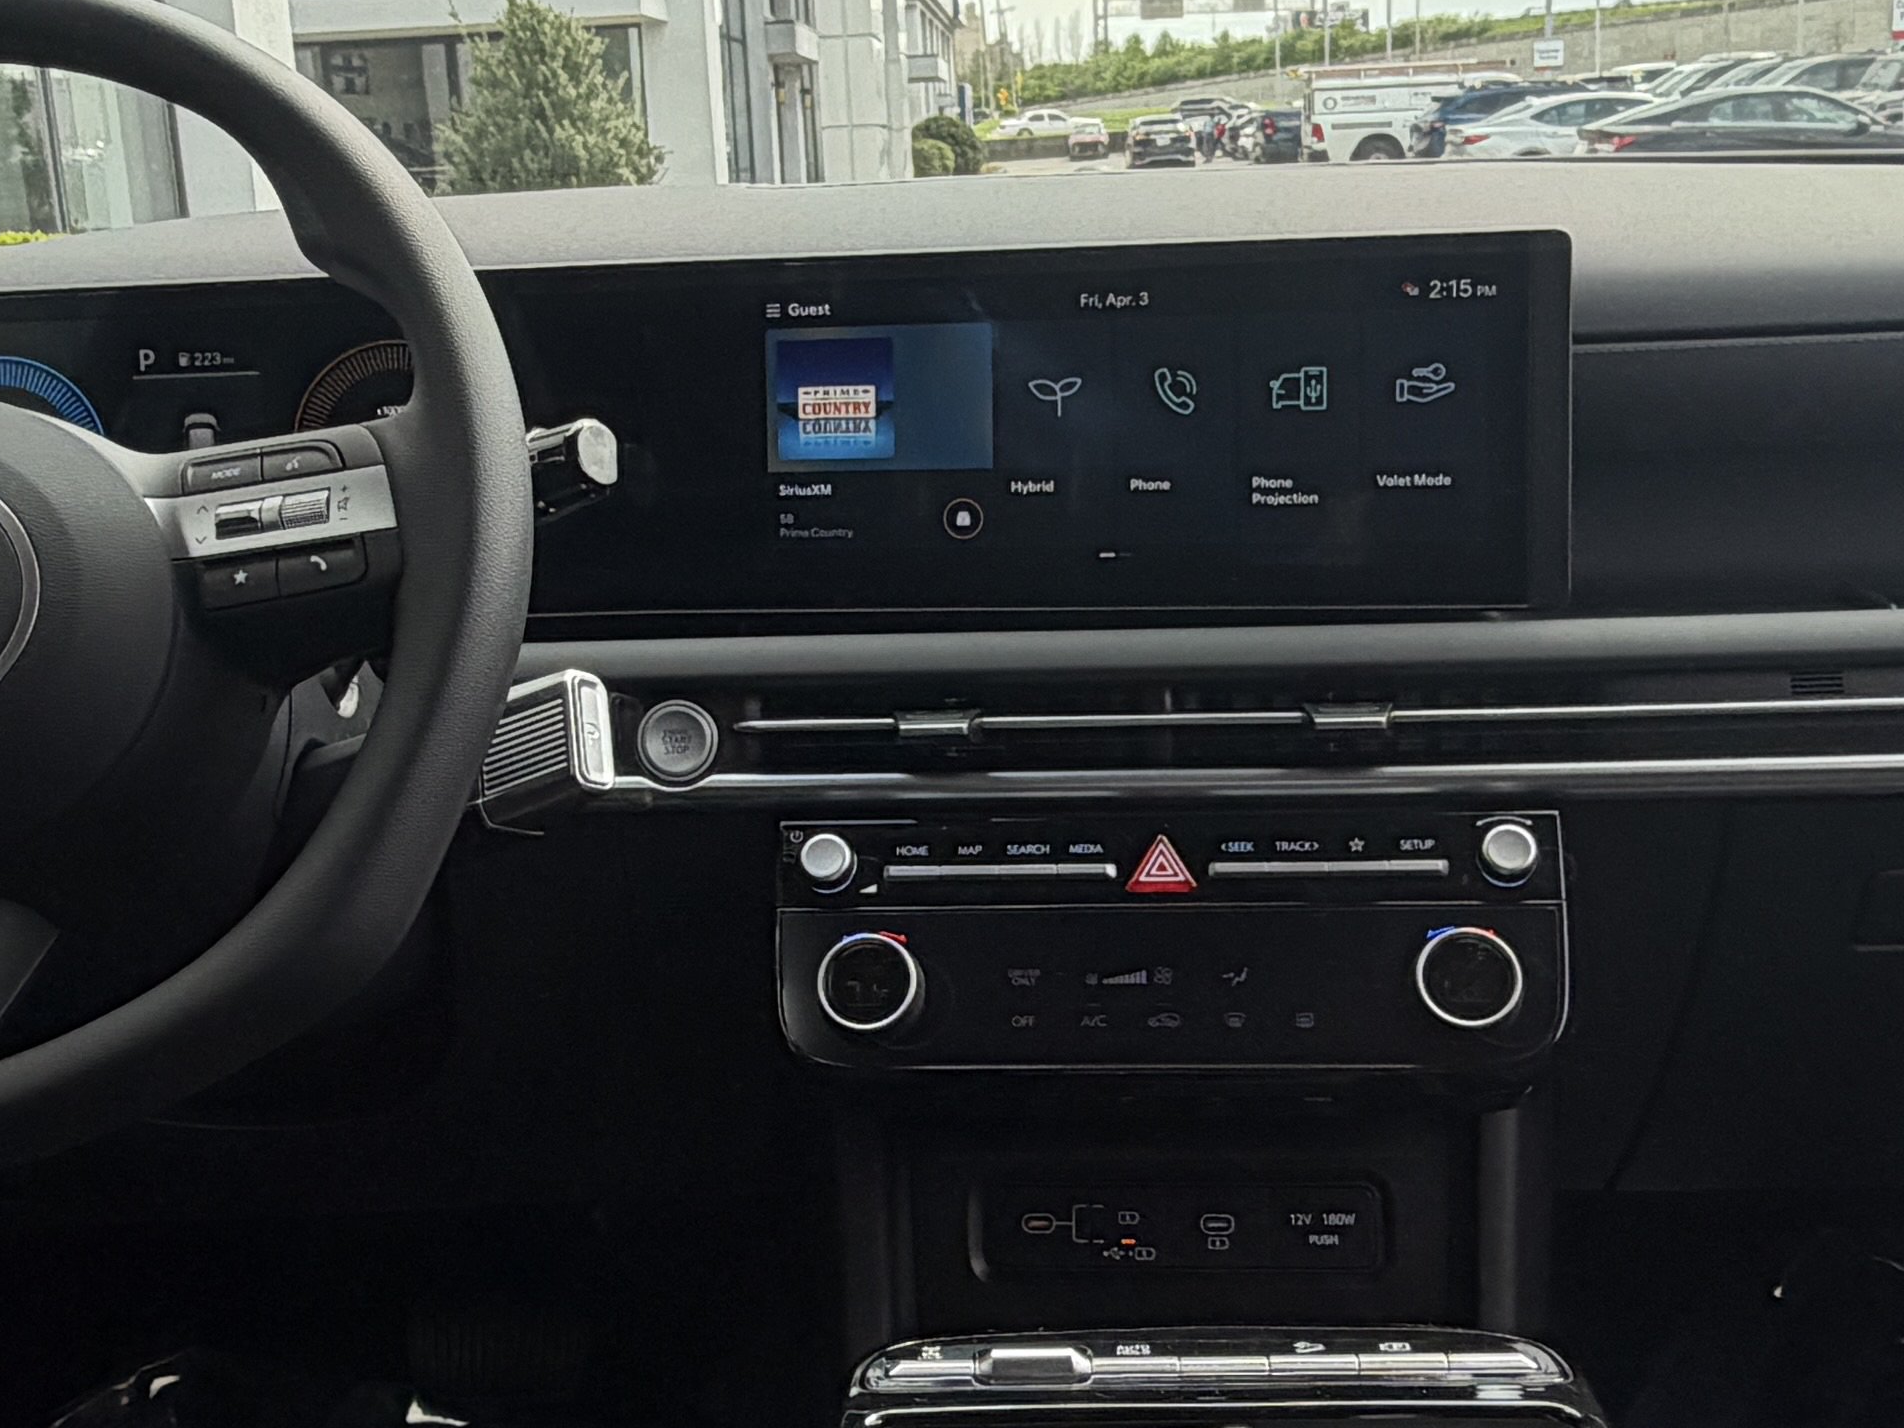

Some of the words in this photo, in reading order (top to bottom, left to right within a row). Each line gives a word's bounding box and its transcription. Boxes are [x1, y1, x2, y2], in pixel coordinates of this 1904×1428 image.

[1428, 279, 1473, 298] 2:15
[1476, 284, 1497, 297] PM
[1080, 293, 1103, 309] Fri,
[1105, 292, 1136, 308] Apr.
[1139, 291, 1150, 306] 3
[787, 303, 832, 317] Guest
[138, 348, 156, 372] P
[801, 401, 872, 416] COUNTRY
[1010, 479, 1055, 495] Hybrid
[1129, 478, 1172, 492] Phone
[1251, 475, 1294, 489] Phone
[1376, 474, 1412, 488] Valet
[1413, 472, 1453, 486] Mode
[778, 483, 833, 496] SiriusXM
[1251, 491, 1320, 506] Projection
[895, 845, 929, 857] HOME
[957, 844, 983, 856] MAP
[1005, 843, 1051, 856] SEARCH
[1068, 842, 1104, 855] MEDIA
[1399, 838, 1436, 851] SETUP
[1011, 1015, 1036, 1028] OFF
[1080, 1015, 1108, 1028] A/C
[1289, 1212, 1313, 1226] 12V
[1322, 1212, 1356, 1226] 180W
[1308, 1233, 1340, 1246] PUSH
